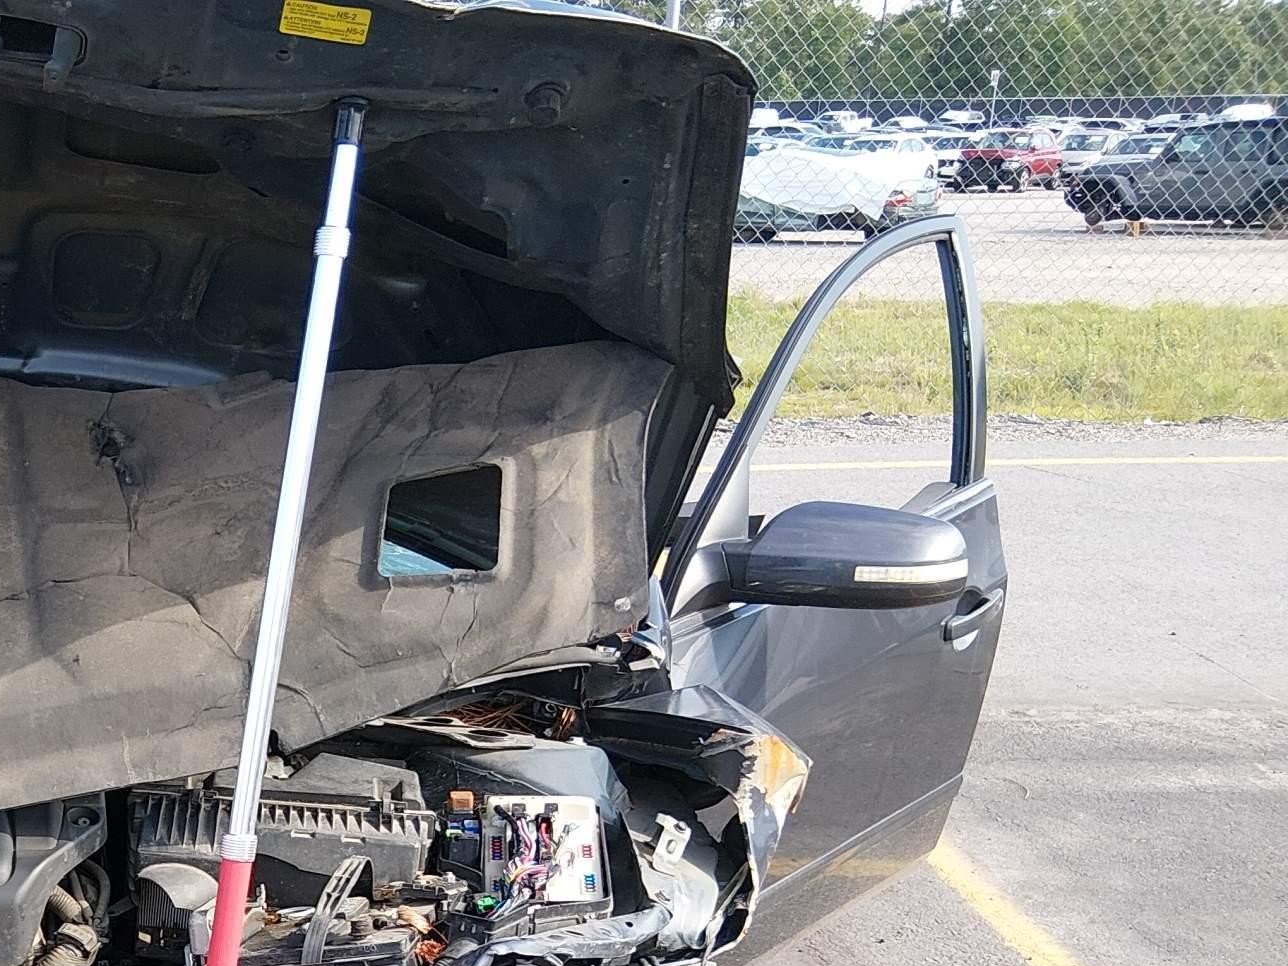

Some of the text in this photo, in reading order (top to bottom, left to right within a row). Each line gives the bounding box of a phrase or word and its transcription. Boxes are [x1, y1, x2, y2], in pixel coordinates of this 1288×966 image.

[292, 2, 317, 10] CAUTION
[336, 11, 358, 20] NS-2
[289, 16, 320, 25] ATTENTION
